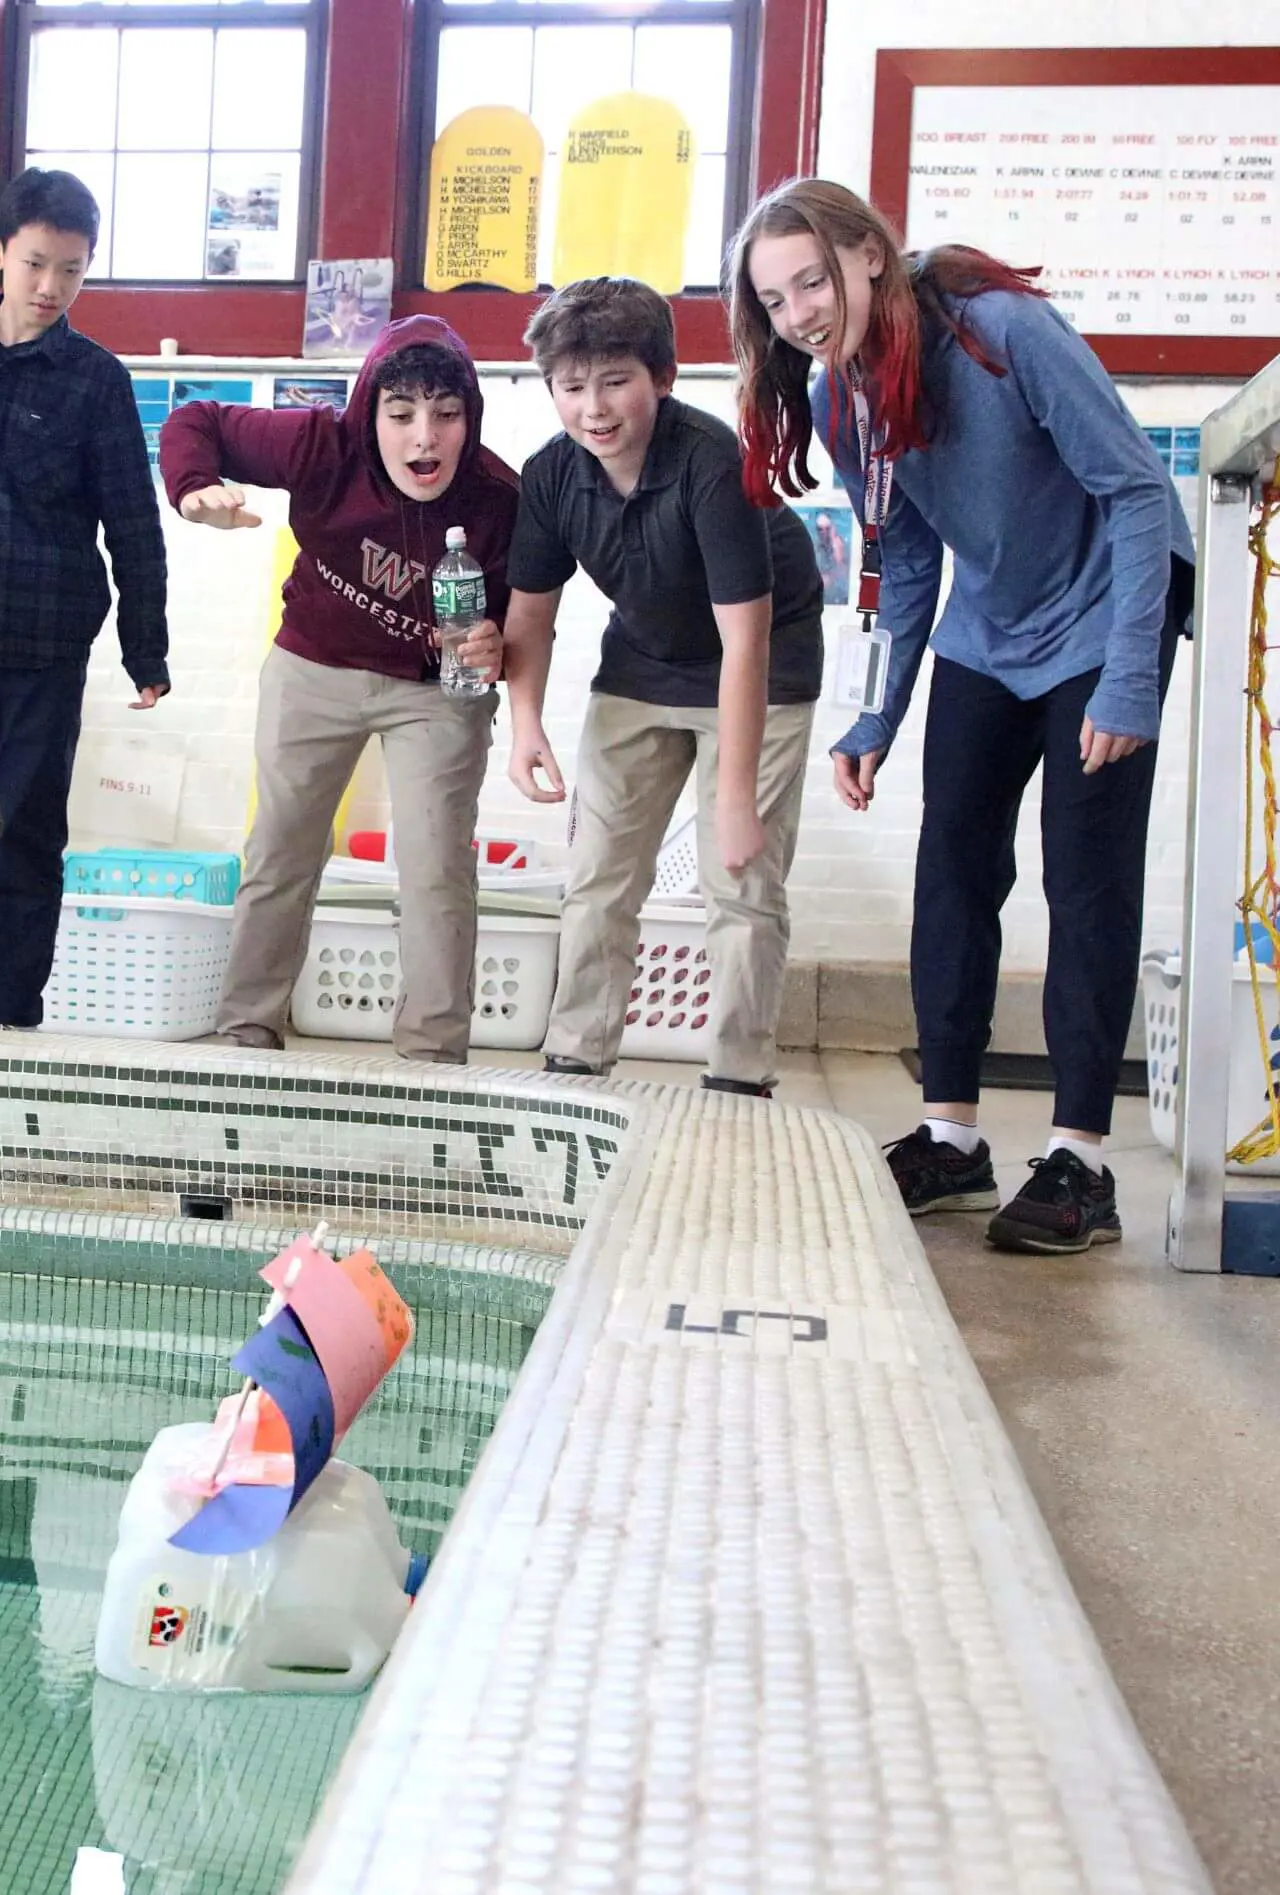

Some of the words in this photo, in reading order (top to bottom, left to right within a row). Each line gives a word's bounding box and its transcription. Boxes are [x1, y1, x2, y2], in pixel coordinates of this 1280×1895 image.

[944, 132, 987, 143] BREAST
[1126, 135, 1156, 145] FREE
[1198, 135, 1217, 145] FLY
[466, 147, 511, 156] GOLDEN
[456, 165, 523, 174] KICKBOARD
[453, 175, 510, 185] MICHELSON
[453, 185, 510, 194] MICHELSON
[452, 205, 510, 215] MICHELSON
[360, 537, 426, 600] W
[317, 558, 430, 636] WORCESTE
[100, 777, 124, 792] FINS
